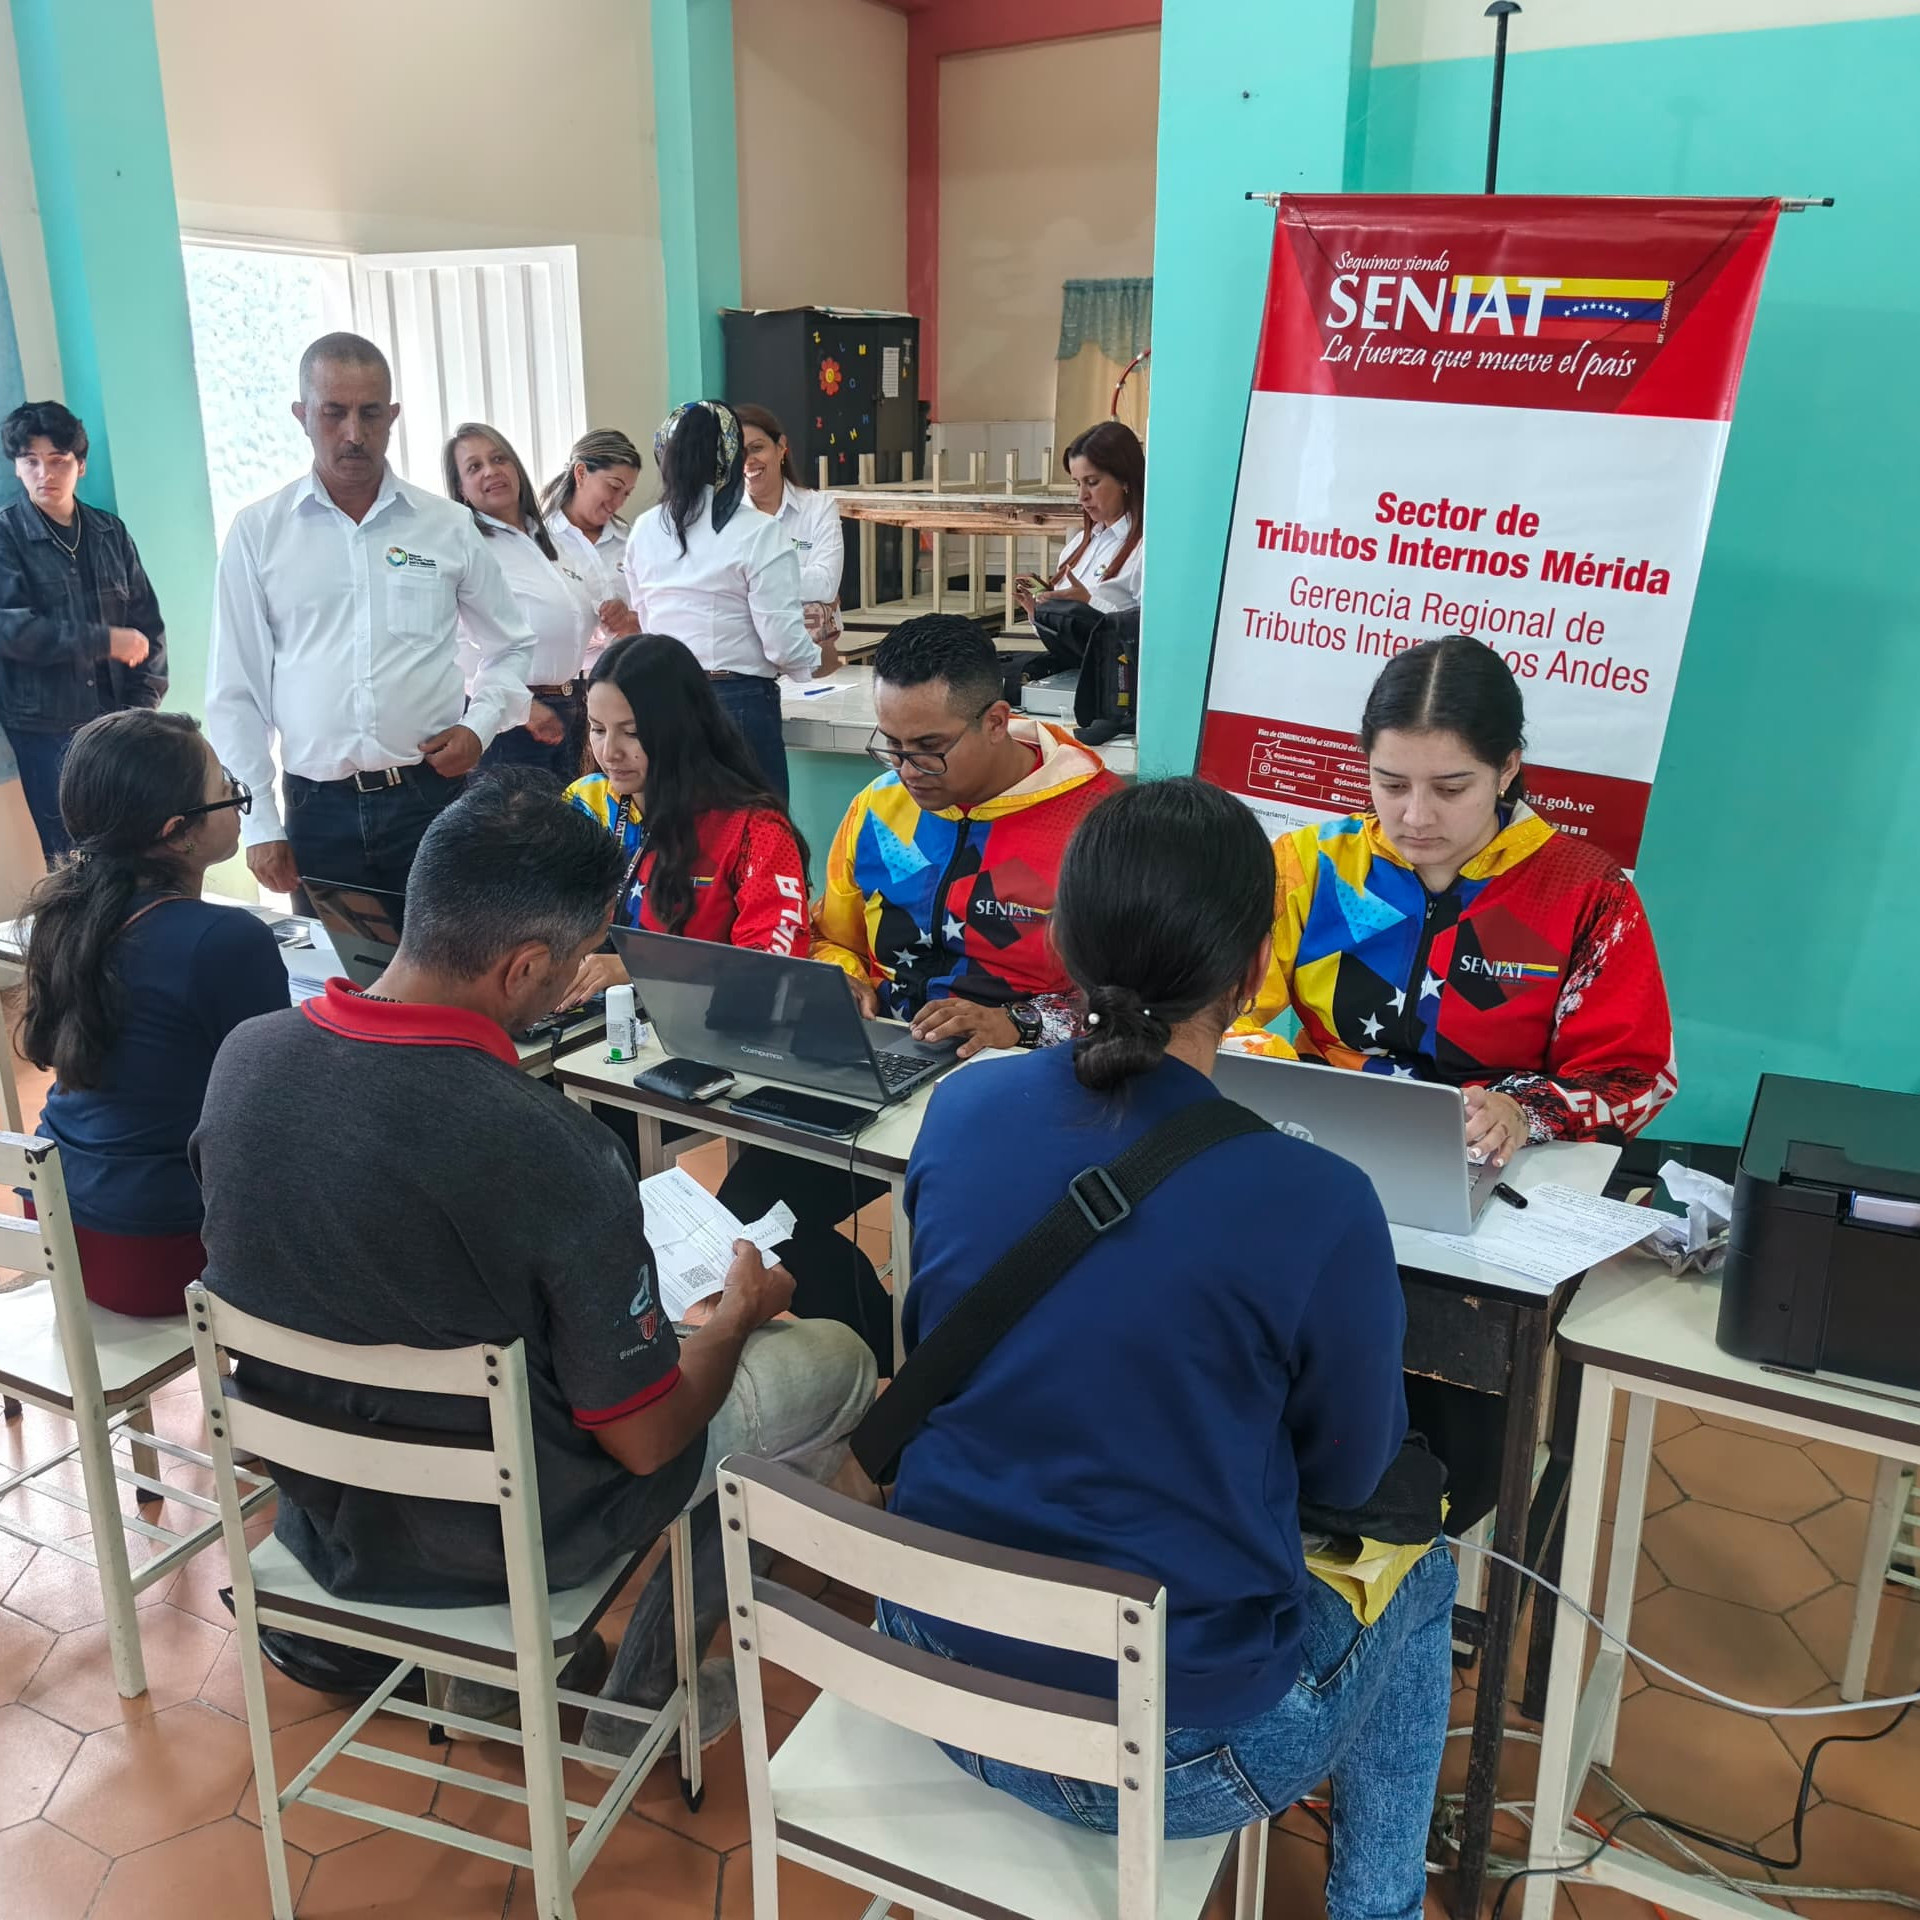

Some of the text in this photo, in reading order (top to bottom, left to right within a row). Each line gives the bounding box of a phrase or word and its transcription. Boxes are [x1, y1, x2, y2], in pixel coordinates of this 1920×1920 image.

[1335, 250, 1450, 276] Seguimos siendo
[1326, 274, 1561, 337] SENIAT
[1320, 333, 1637, 391] La fuerza que mueve el país
[1374, 491, 1540, 538] Sector de
[1255, 519, 1671, 595] Tributos Internos Mérida
[1289, 576, 1605, 646] Gerencia Regional de
[1243, 608, 1347, 651] Tributos
[1356, 624, 1425, 658] Inter
[1546, 650, 1650, 694] Andes
[1524, 789, 1595, 814] iat.gob.ve
[975, 899, 1032, 918] SENIAT
[1459, 954, 1526, 979] SENIAT
